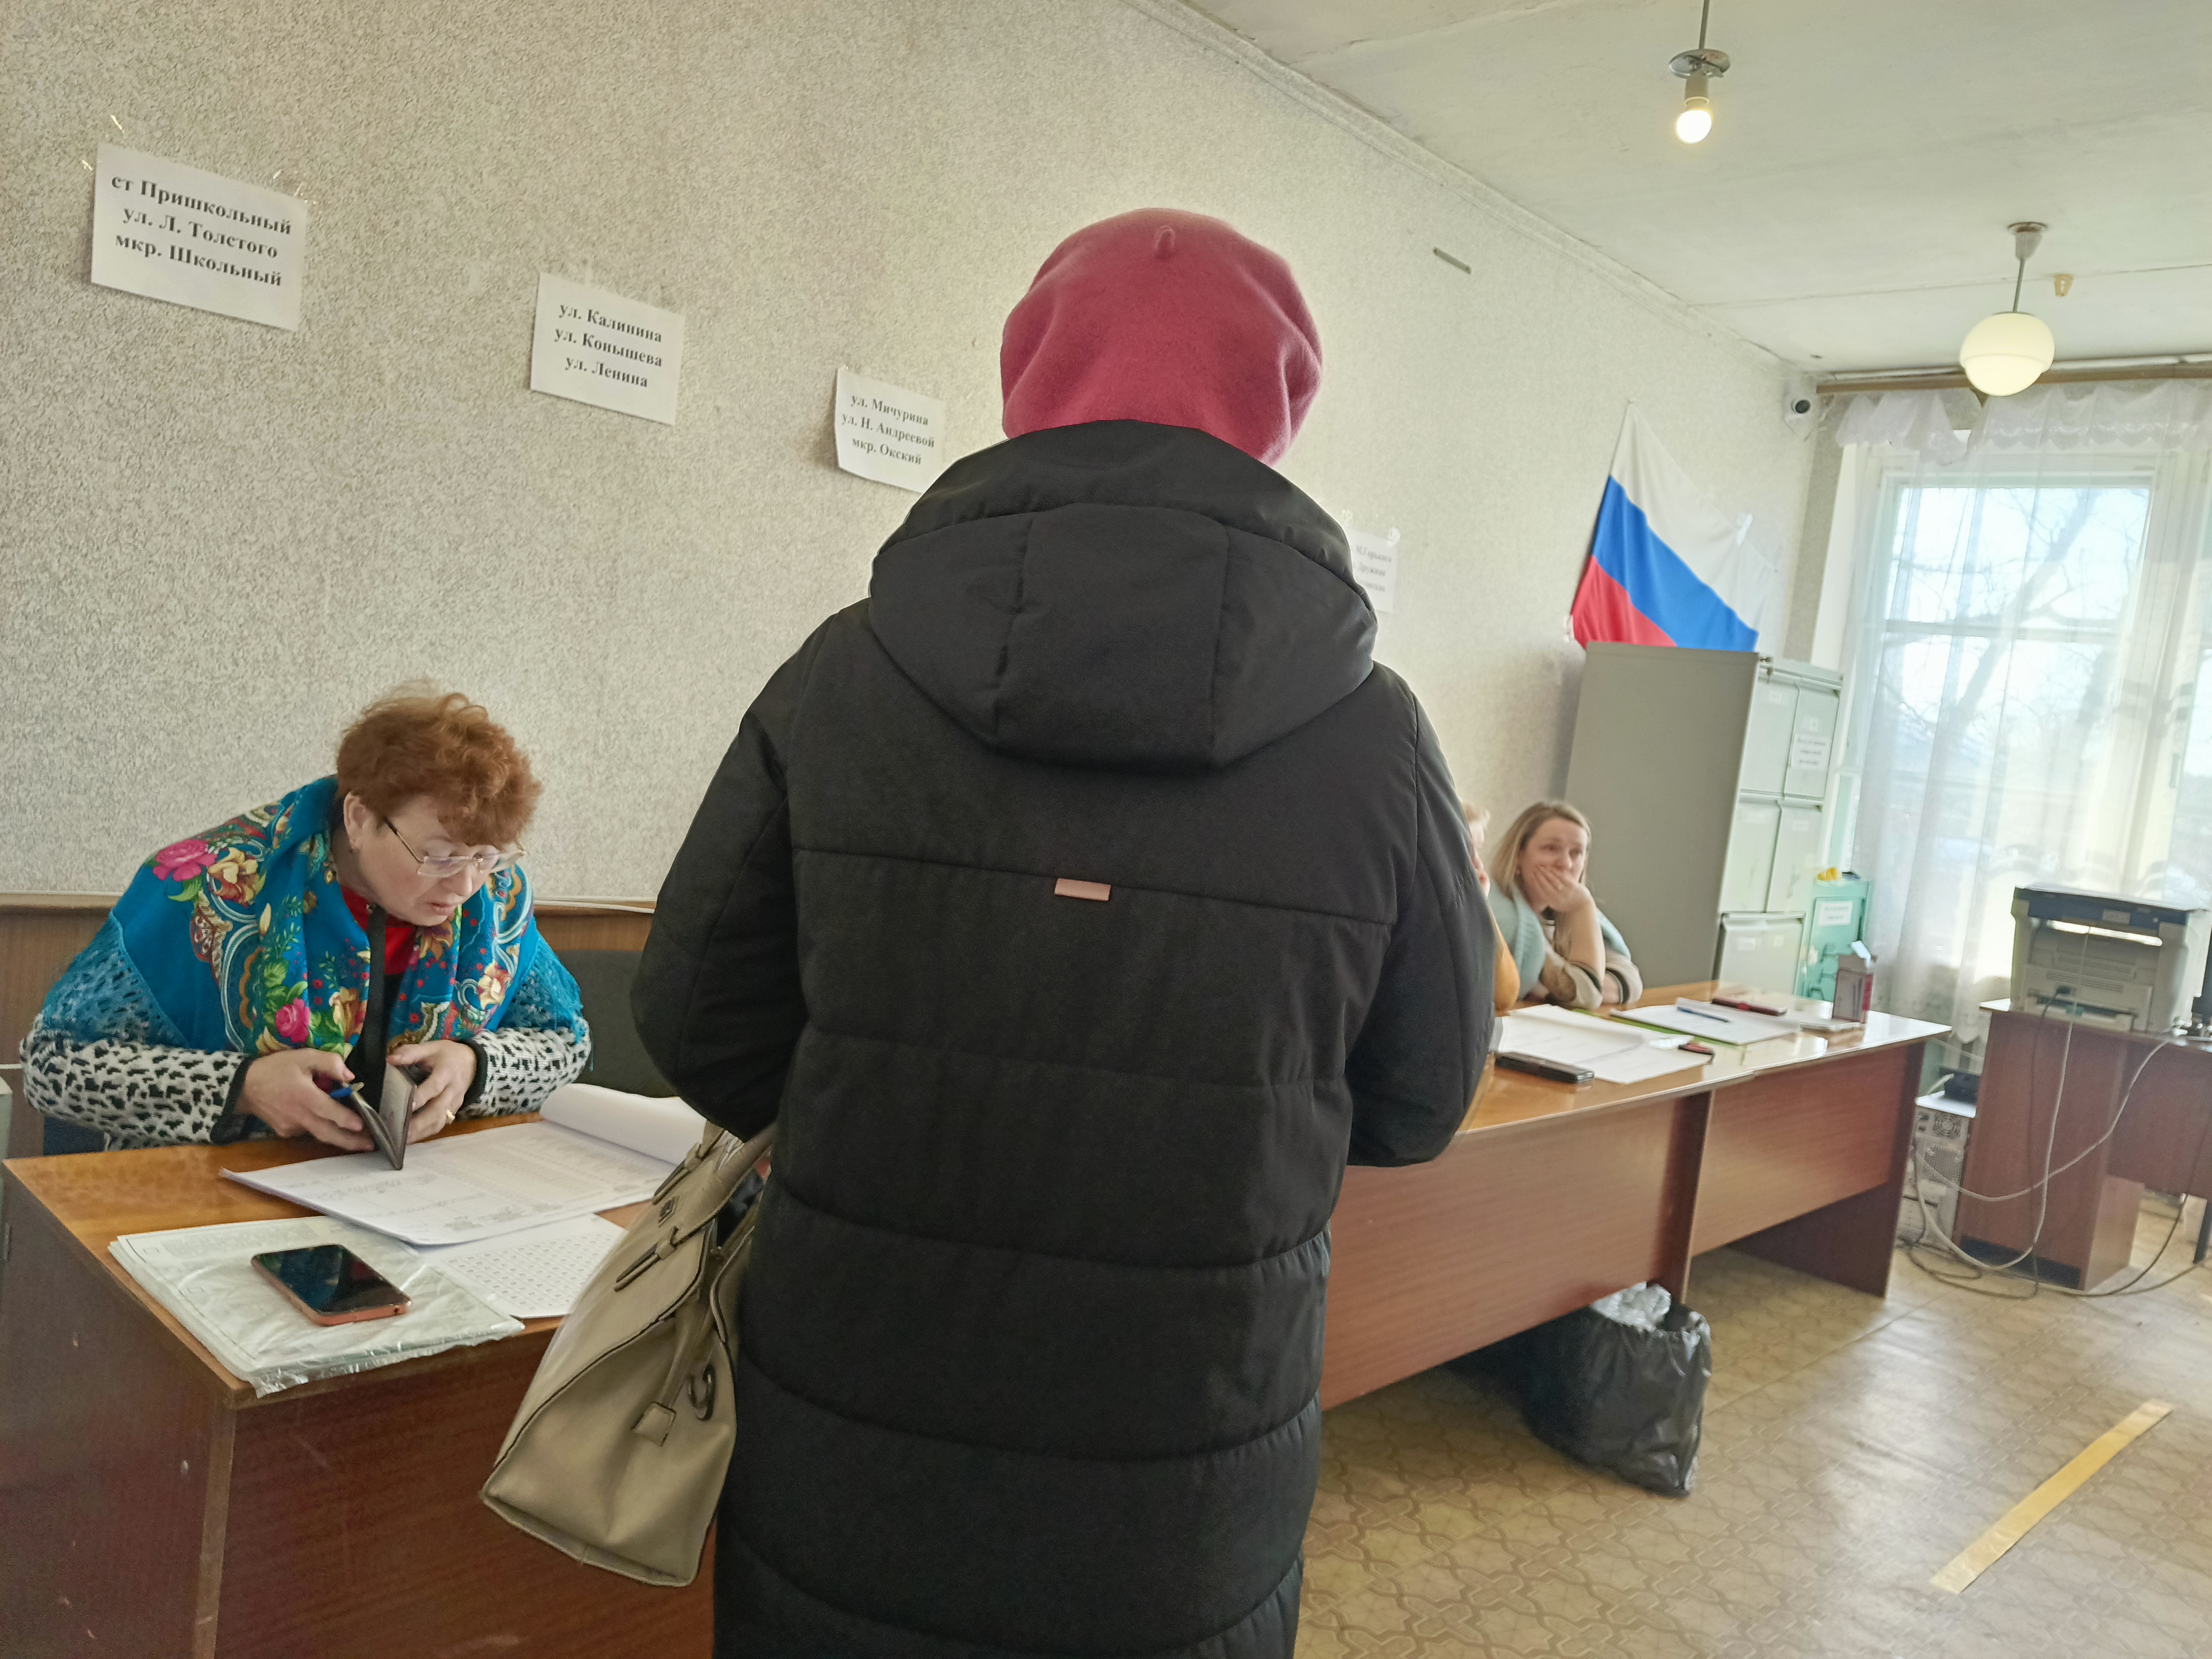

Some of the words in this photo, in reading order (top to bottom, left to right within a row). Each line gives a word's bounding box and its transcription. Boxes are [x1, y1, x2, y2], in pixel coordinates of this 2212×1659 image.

[111, 176, 134, 191] ст
[141, 180, 292, 235] Пришкольный
[122, 207, 153, 226] ул.
[158, 215, 182, 234] Л.
[188, 220, 278, 259] Толстого
[115, 234, 162, 258] мкр.
[169, 244, 282, 287] Школьный
[558, 304, 582, 320] ул.
[587, 308, 662, 343] Калинина
[554, 328, 577, 344] ул.
[582, 333, 662, 367] Конышева
[565, 357, 587, 372] ул.
[591, 361, 648, 388] Ленина
[851, 395, 868, 408] ул.
[872, 398, 928, 426] Мичурина
[842, 413, 857, 426] ул.
[861, 417, 873, 431] Н.
[877, 422, 935, 448] Андреевой
[852, 438, 877, 454] мкр.
[879, 443, 922, 465] Окский
